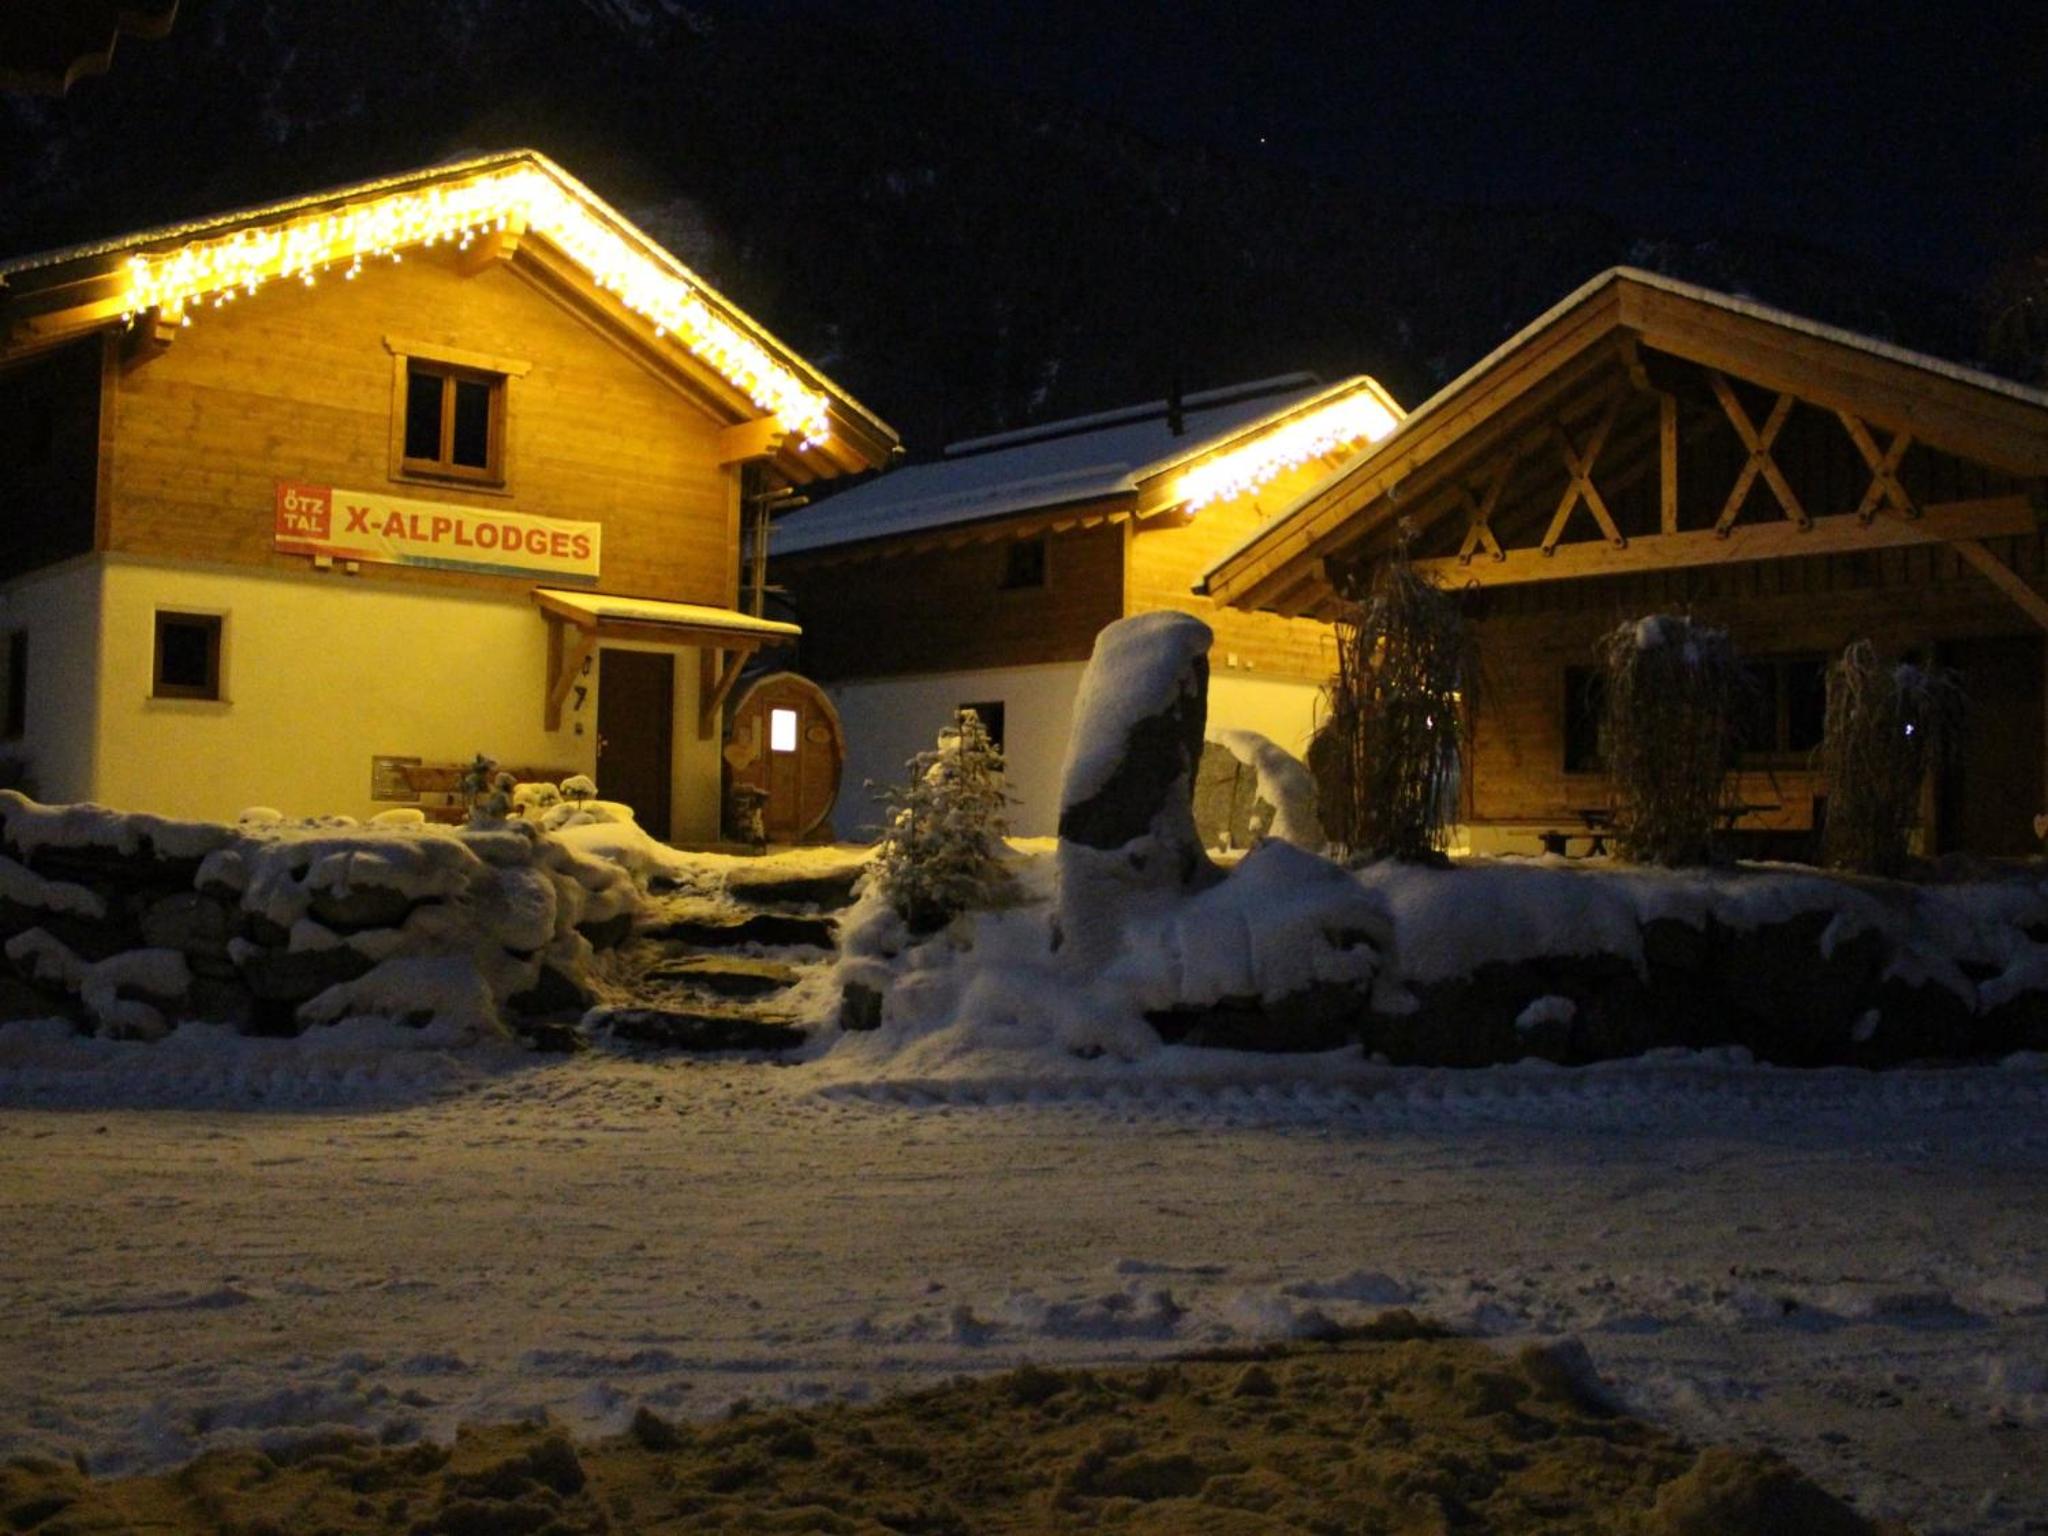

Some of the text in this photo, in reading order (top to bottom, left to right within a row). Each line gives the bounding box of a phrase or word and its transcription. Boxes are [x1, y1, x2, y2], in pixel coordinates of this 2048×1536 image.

[284, 489, 324, 514] ÖTZ
[283, 513, 323, 532] TAL
[345, 506, 591, 560] X-ALPLODGES
